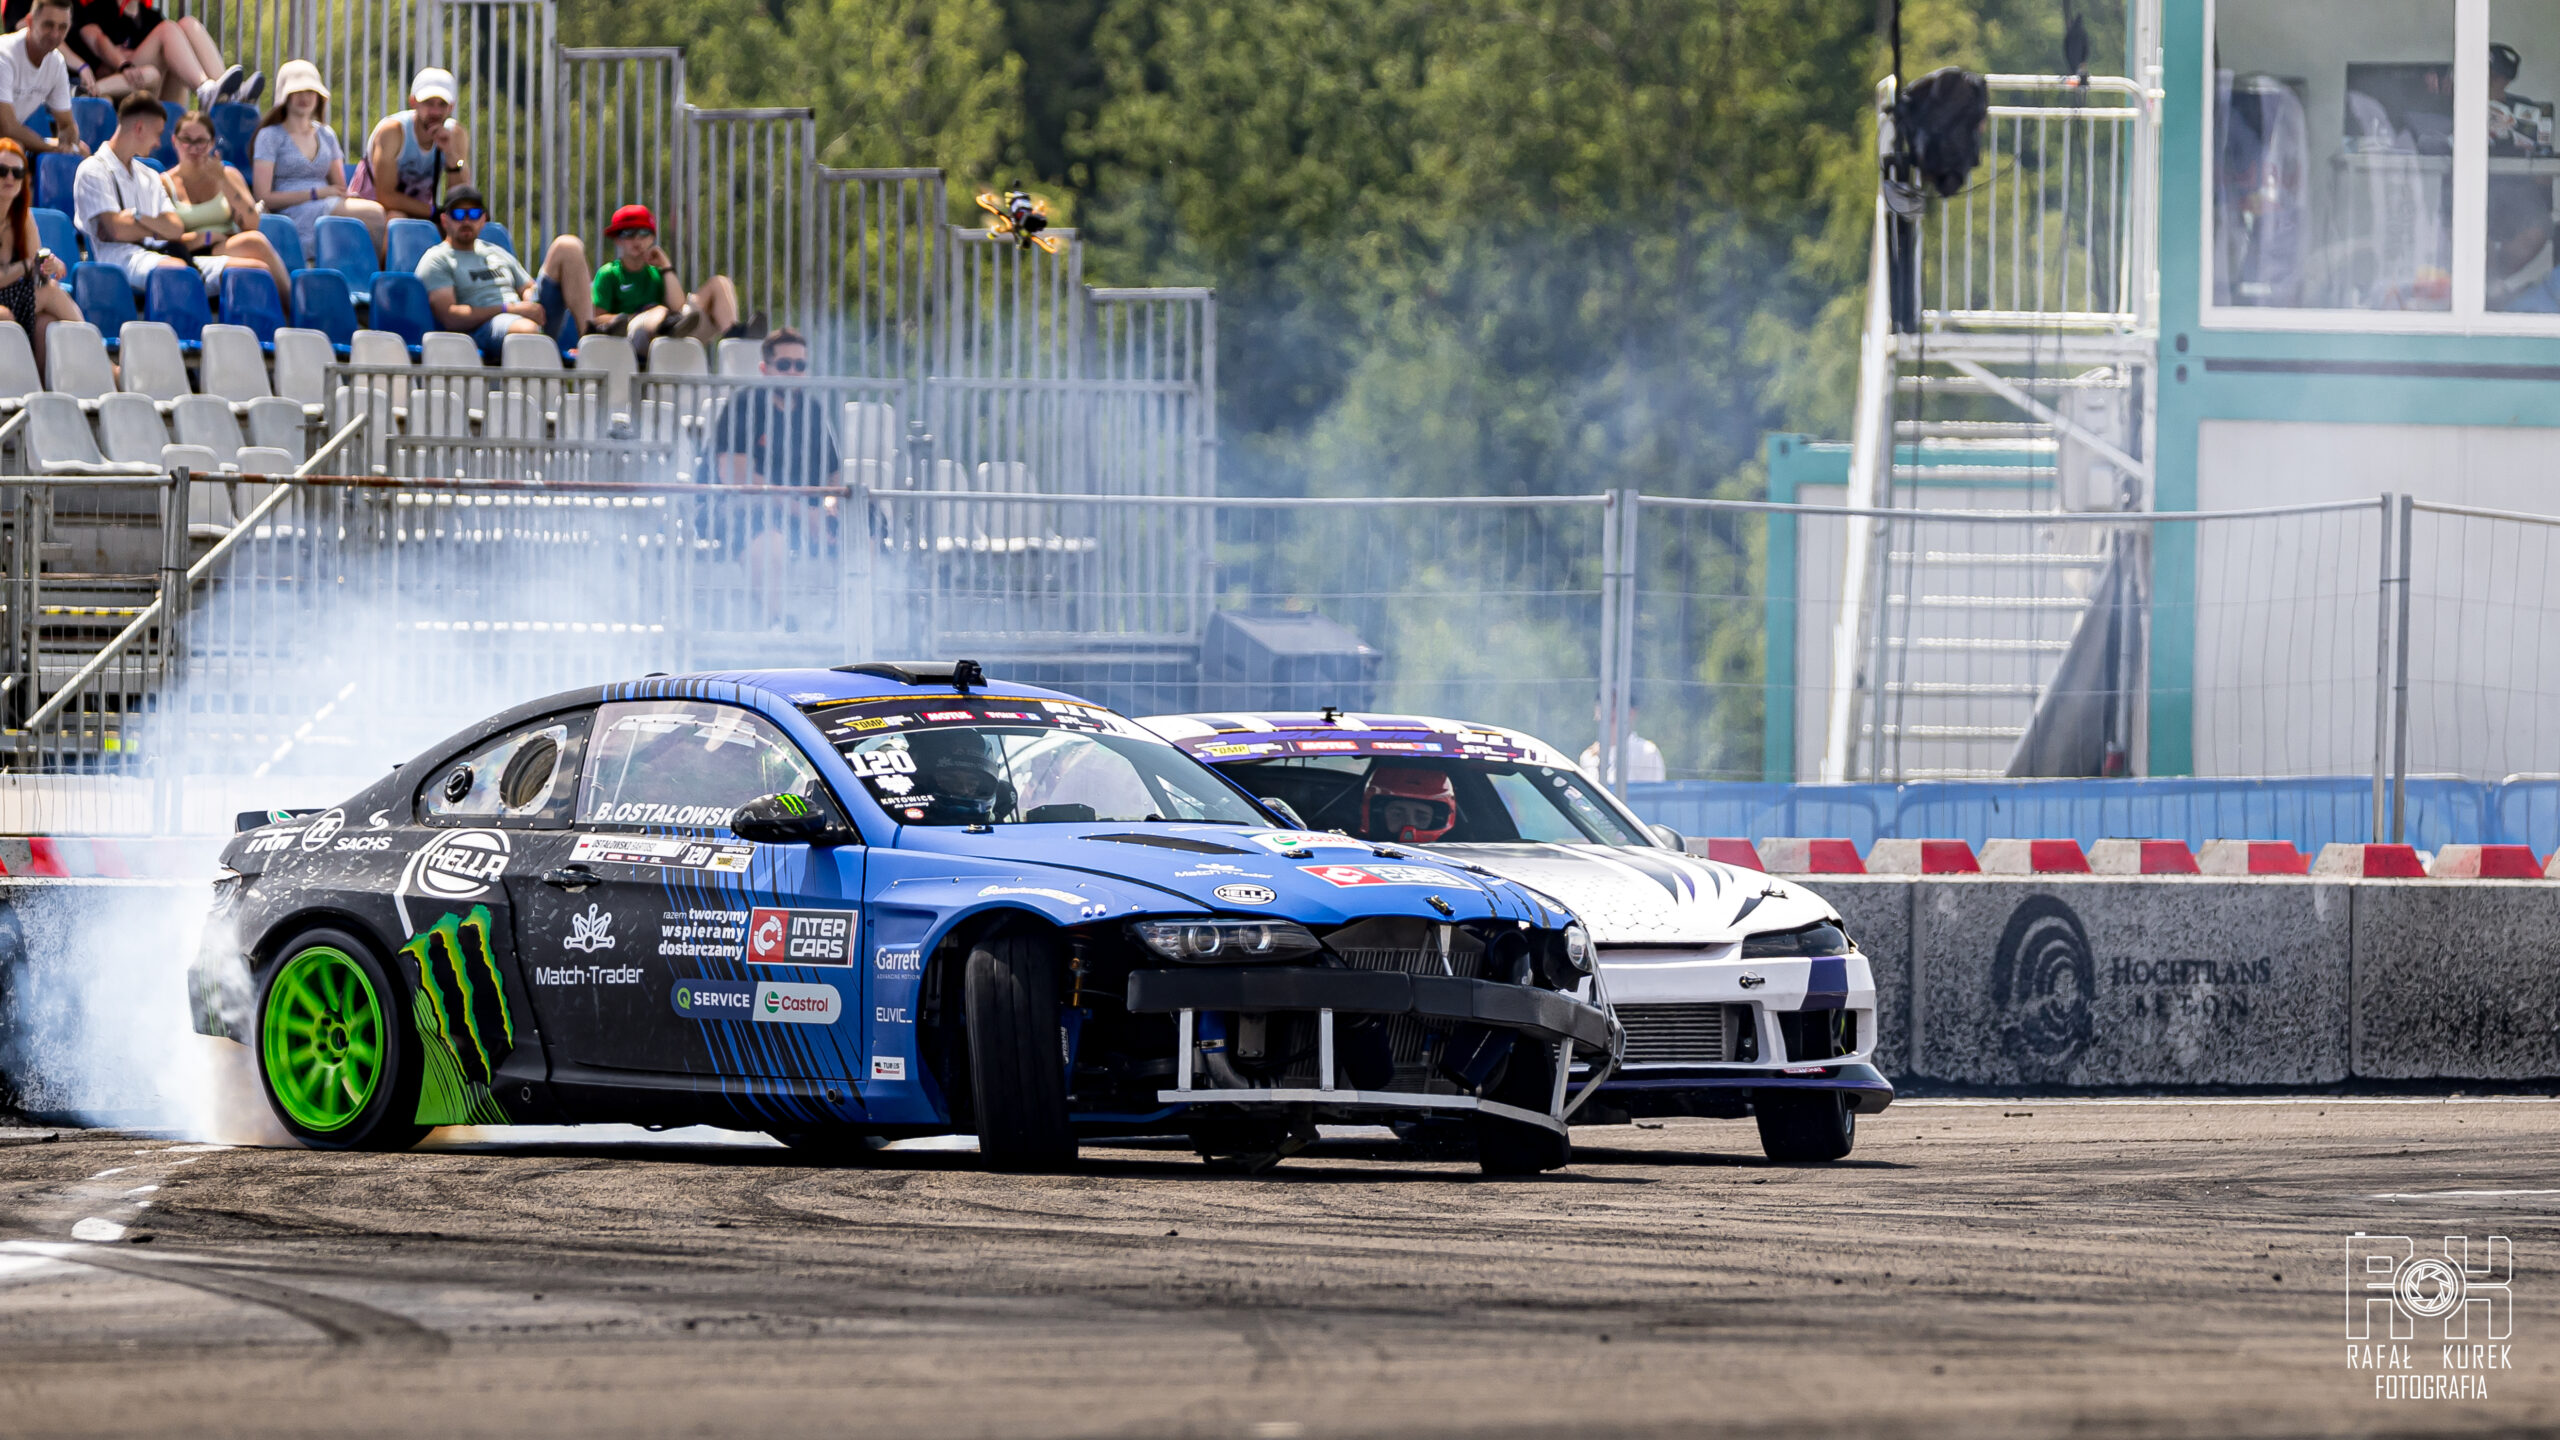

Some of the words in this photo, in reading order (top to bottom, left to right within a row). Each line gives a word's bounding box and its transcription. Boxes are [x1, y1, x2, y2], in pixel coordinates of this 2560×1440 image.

[844, 749, 918, 777] 120
[880, 794, 936, 805] KATOWICE
[593, 802, 738, 827] B.OSTAŁOWSK
[333, 836, 393, 851] SACHS
[428, 846, 510, 883] HELLA
[681, 845, 713, 866] 120
[1218, 888, 1276, 901] HELLA
[663, 910, 688, 920] razem
[688, 907, 749, 924] tworzymy
[661, 921, 746, 943] wspieramy
[791, 916, 847, 939] INTER
[658, 939, 745, 961] dostarczamy
[789, 938, 844, 959] CARS
[876, 946, 921, 971] Garrett
[693, 991, 751, 1008] SERVICE
[781, 995, 829, 1012] Castrol
